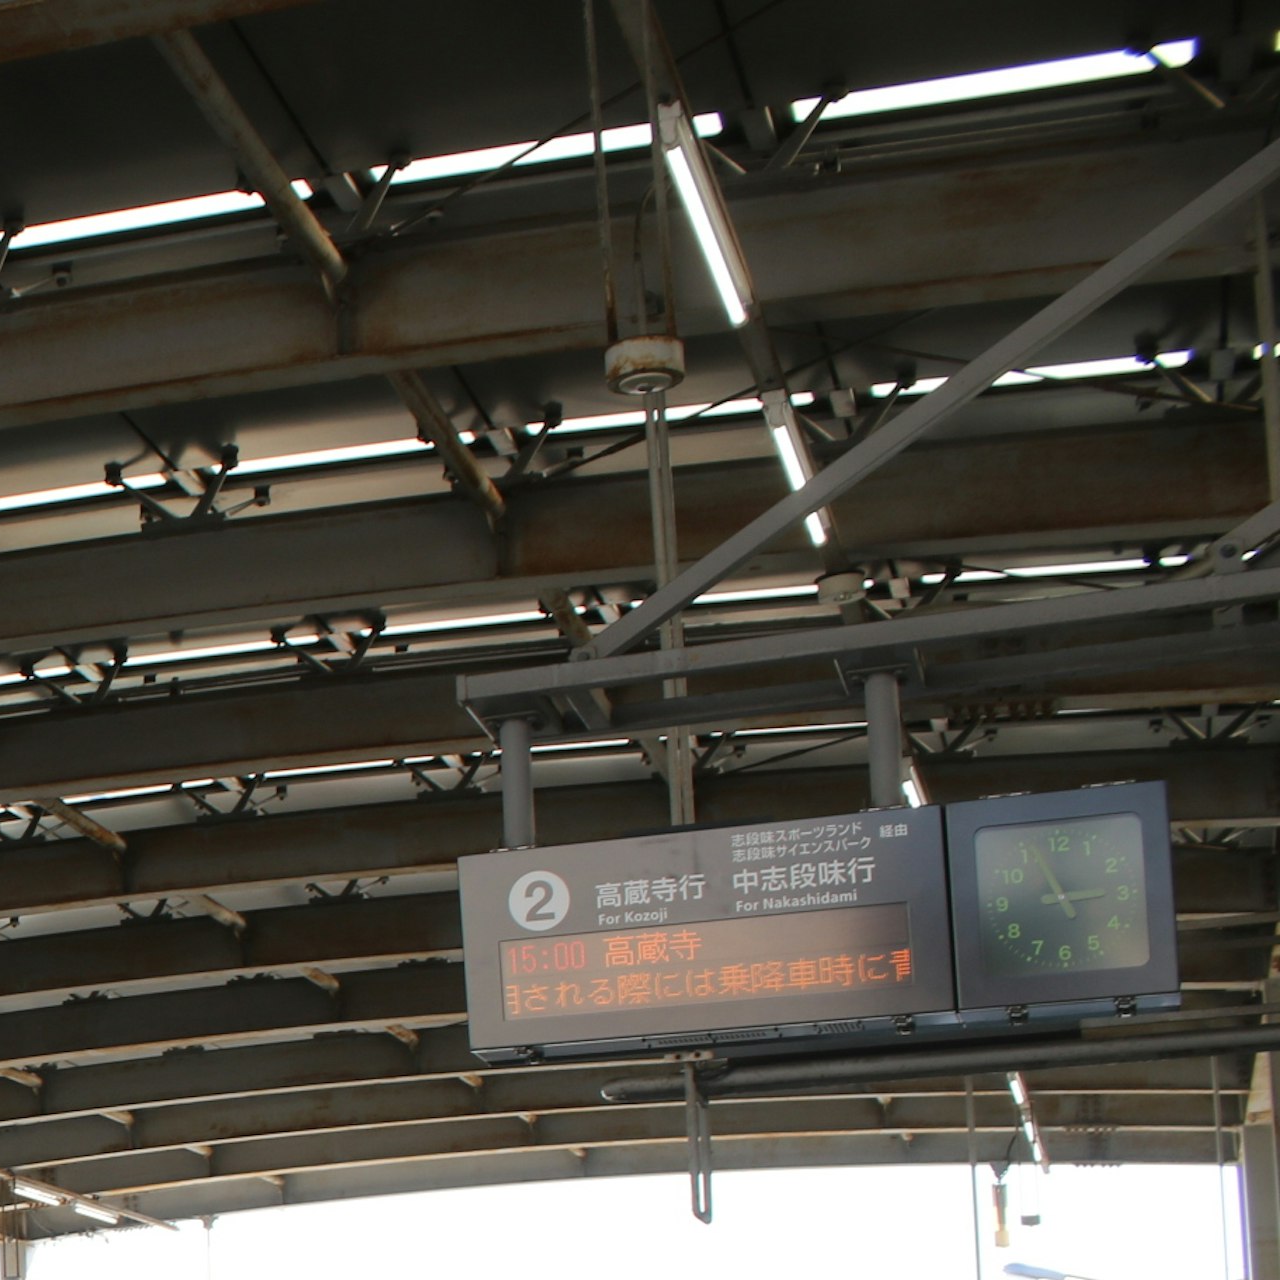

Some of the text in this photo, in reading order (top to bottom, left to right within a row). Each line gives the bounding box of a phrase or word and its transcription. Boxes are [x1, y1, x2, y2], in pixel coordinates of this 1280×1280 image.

[730, 820, 863, 848] 志段味スポーツランド
[879, 823, 908, 838] 経由
[732, 836, 872, 863] 志段味サイエンスパーク
[1048, 836, 1070, 852] 12
[1082, 840, 1092, 856] 1
[1019, 848, 1039, 864] 1
[1105, 857, 1118, 873] 2
[733, 855, 876, 895] 中志段味行
[1002, 868, 1024, 884] 10
[594, 873, 706, 909] 高蔵寺行
[1117, 885, 1130, 901] 3
[524, 880, 556, 923] 2
[735, 888, 858, 912] For Nakashidami
[996, 896, 1009, 912] 9
[598, 907, 668, 926] For Kozoji
[1106, 915, 1120, 931] 4
[1007, 923, 1021, 939] 8
[1031, 940, 1044, 956] 7
[1087, 935, 1100, 950] 5
[507, 928, 704, 975] 15:00 高蔵寺
[1059, 945, 1072, 961] 6
